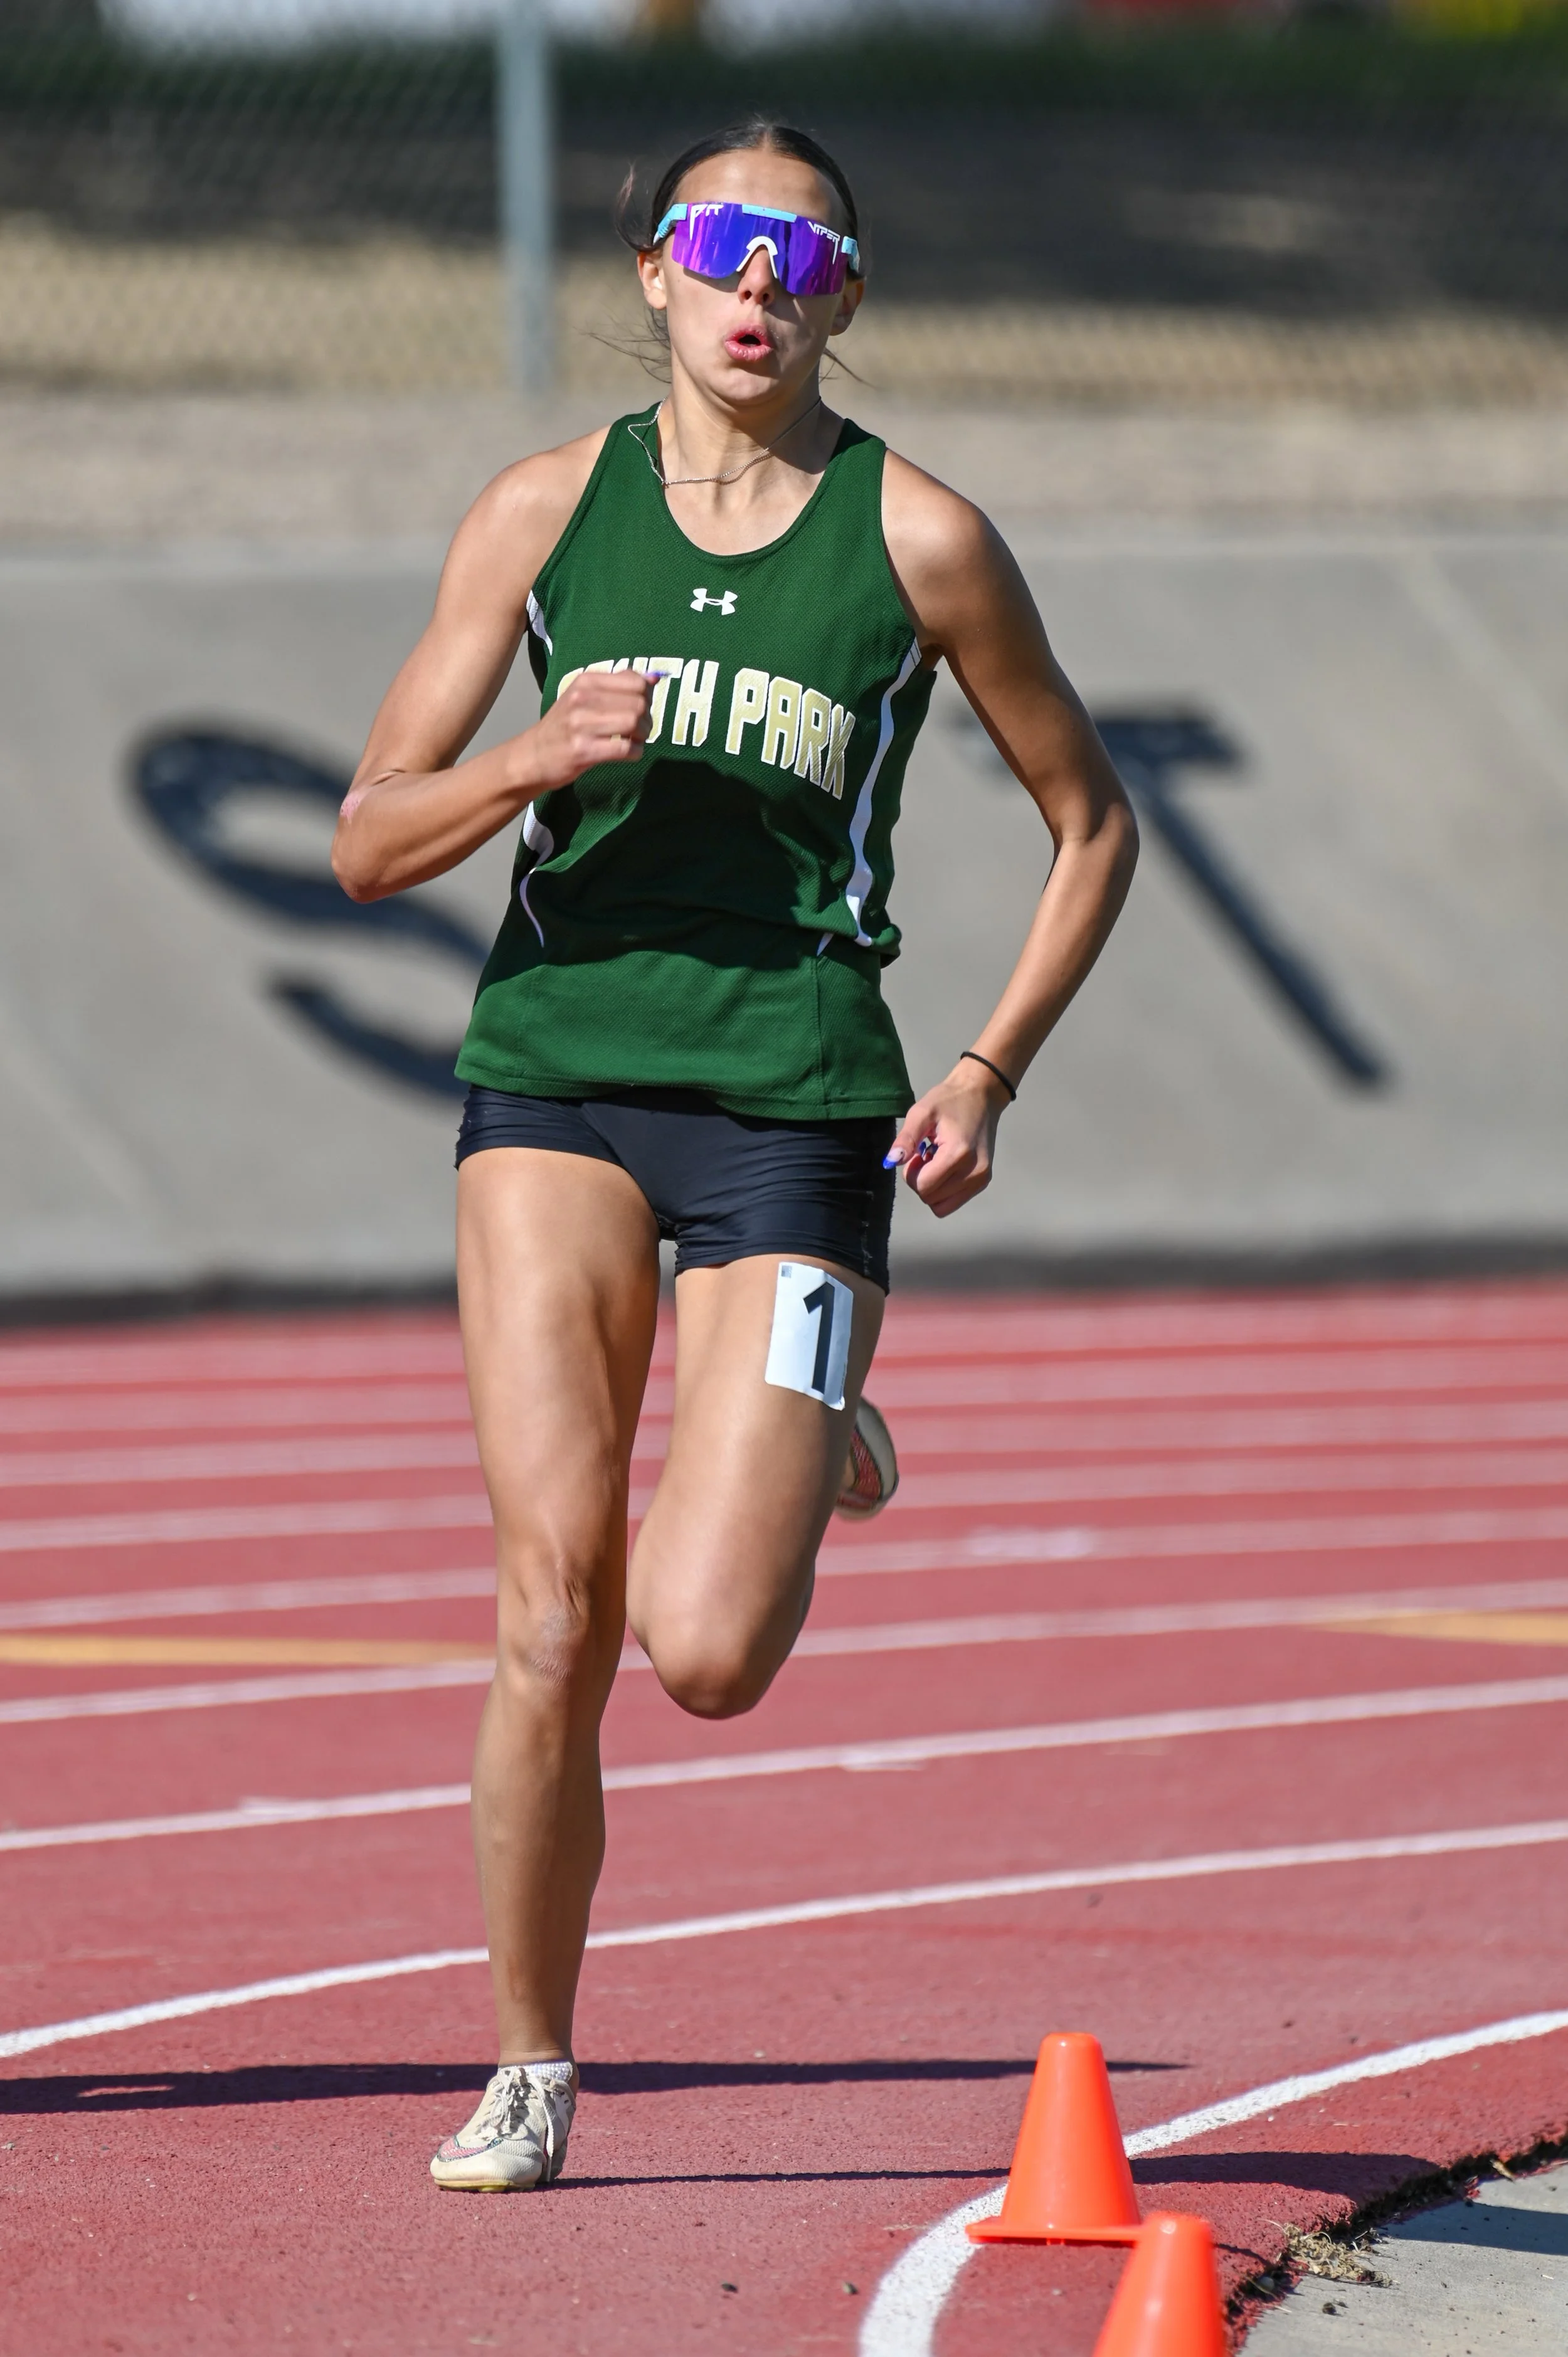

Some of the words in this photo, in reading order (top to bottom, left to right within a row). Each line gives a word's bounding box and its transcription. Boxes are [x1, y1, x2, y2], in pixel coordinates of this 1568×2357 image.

[690, 204, 724, 241] PIT
[807, 221, 840, 265] VIPER
[725, 667, 856, 800] PARK
[803, 1281, 835, 1394] 1
